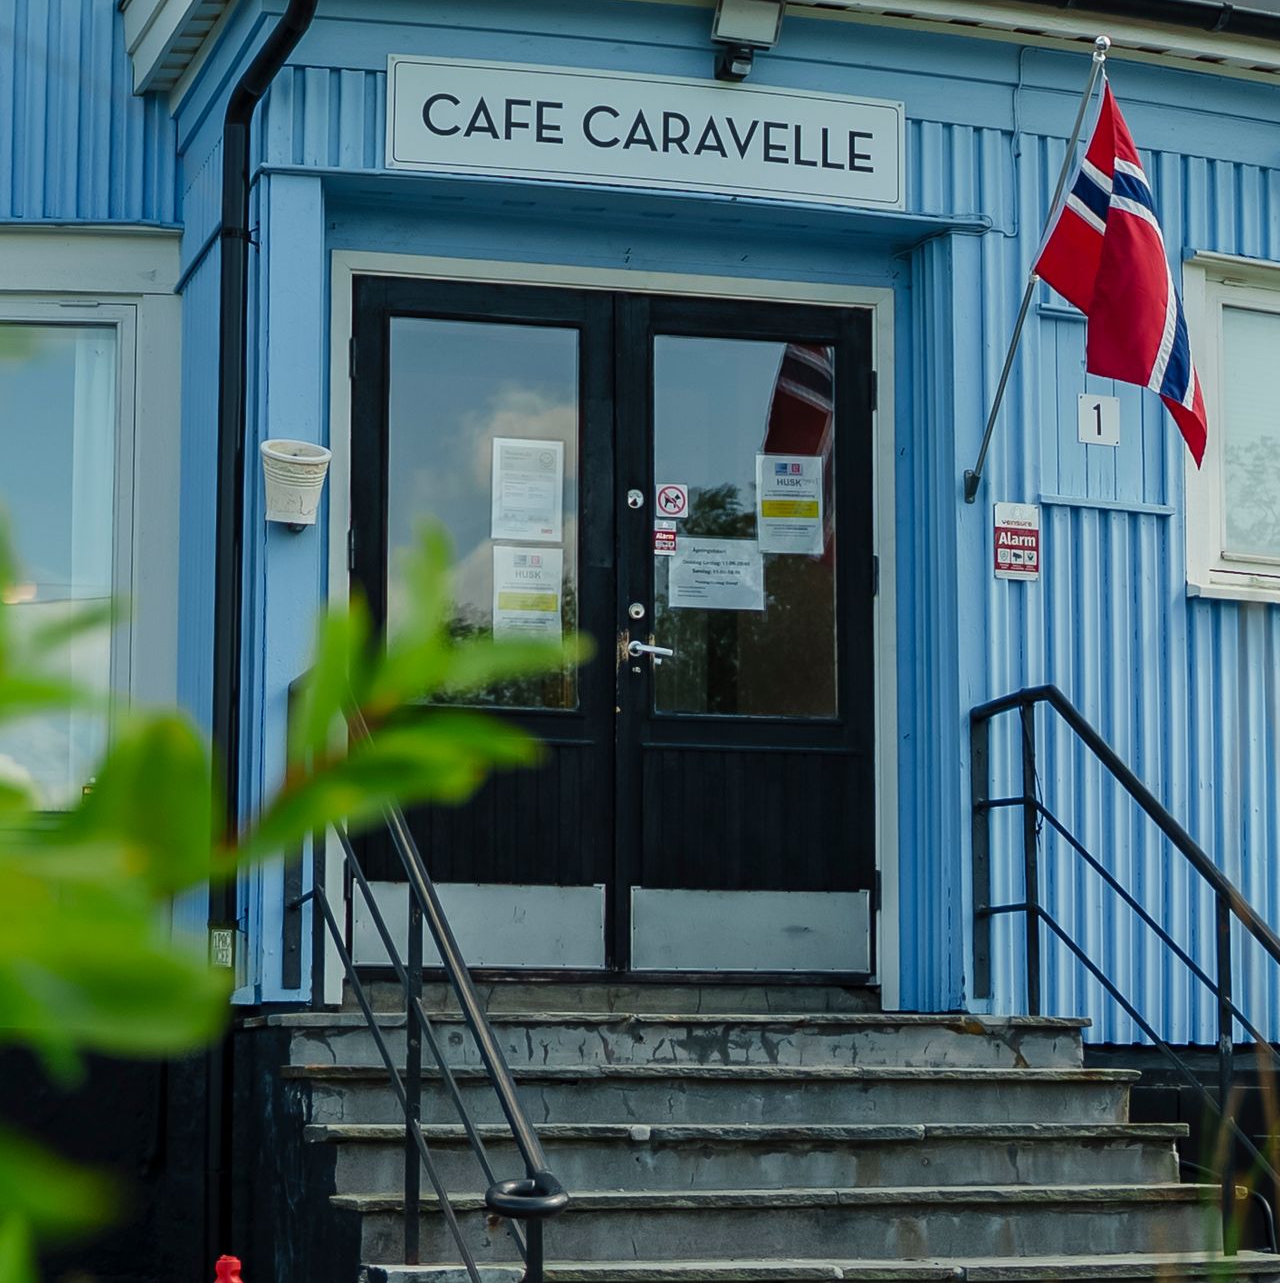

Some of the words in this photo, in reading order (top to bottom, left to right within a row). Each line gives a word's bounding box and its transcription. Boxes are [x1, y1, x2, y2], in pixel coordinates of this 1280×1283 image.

[421, 92, 564, 145] CAFE
[582, 104, 875, 174] CARAVELLE
[1092, 403, 1102, 436] 1
[776, 478, 802, 487] HUSK
[656, 532, 675, 540] Alarm
[998, 531, 1036, 547] Alarm
[515, 569, 542, 579] HUSK
